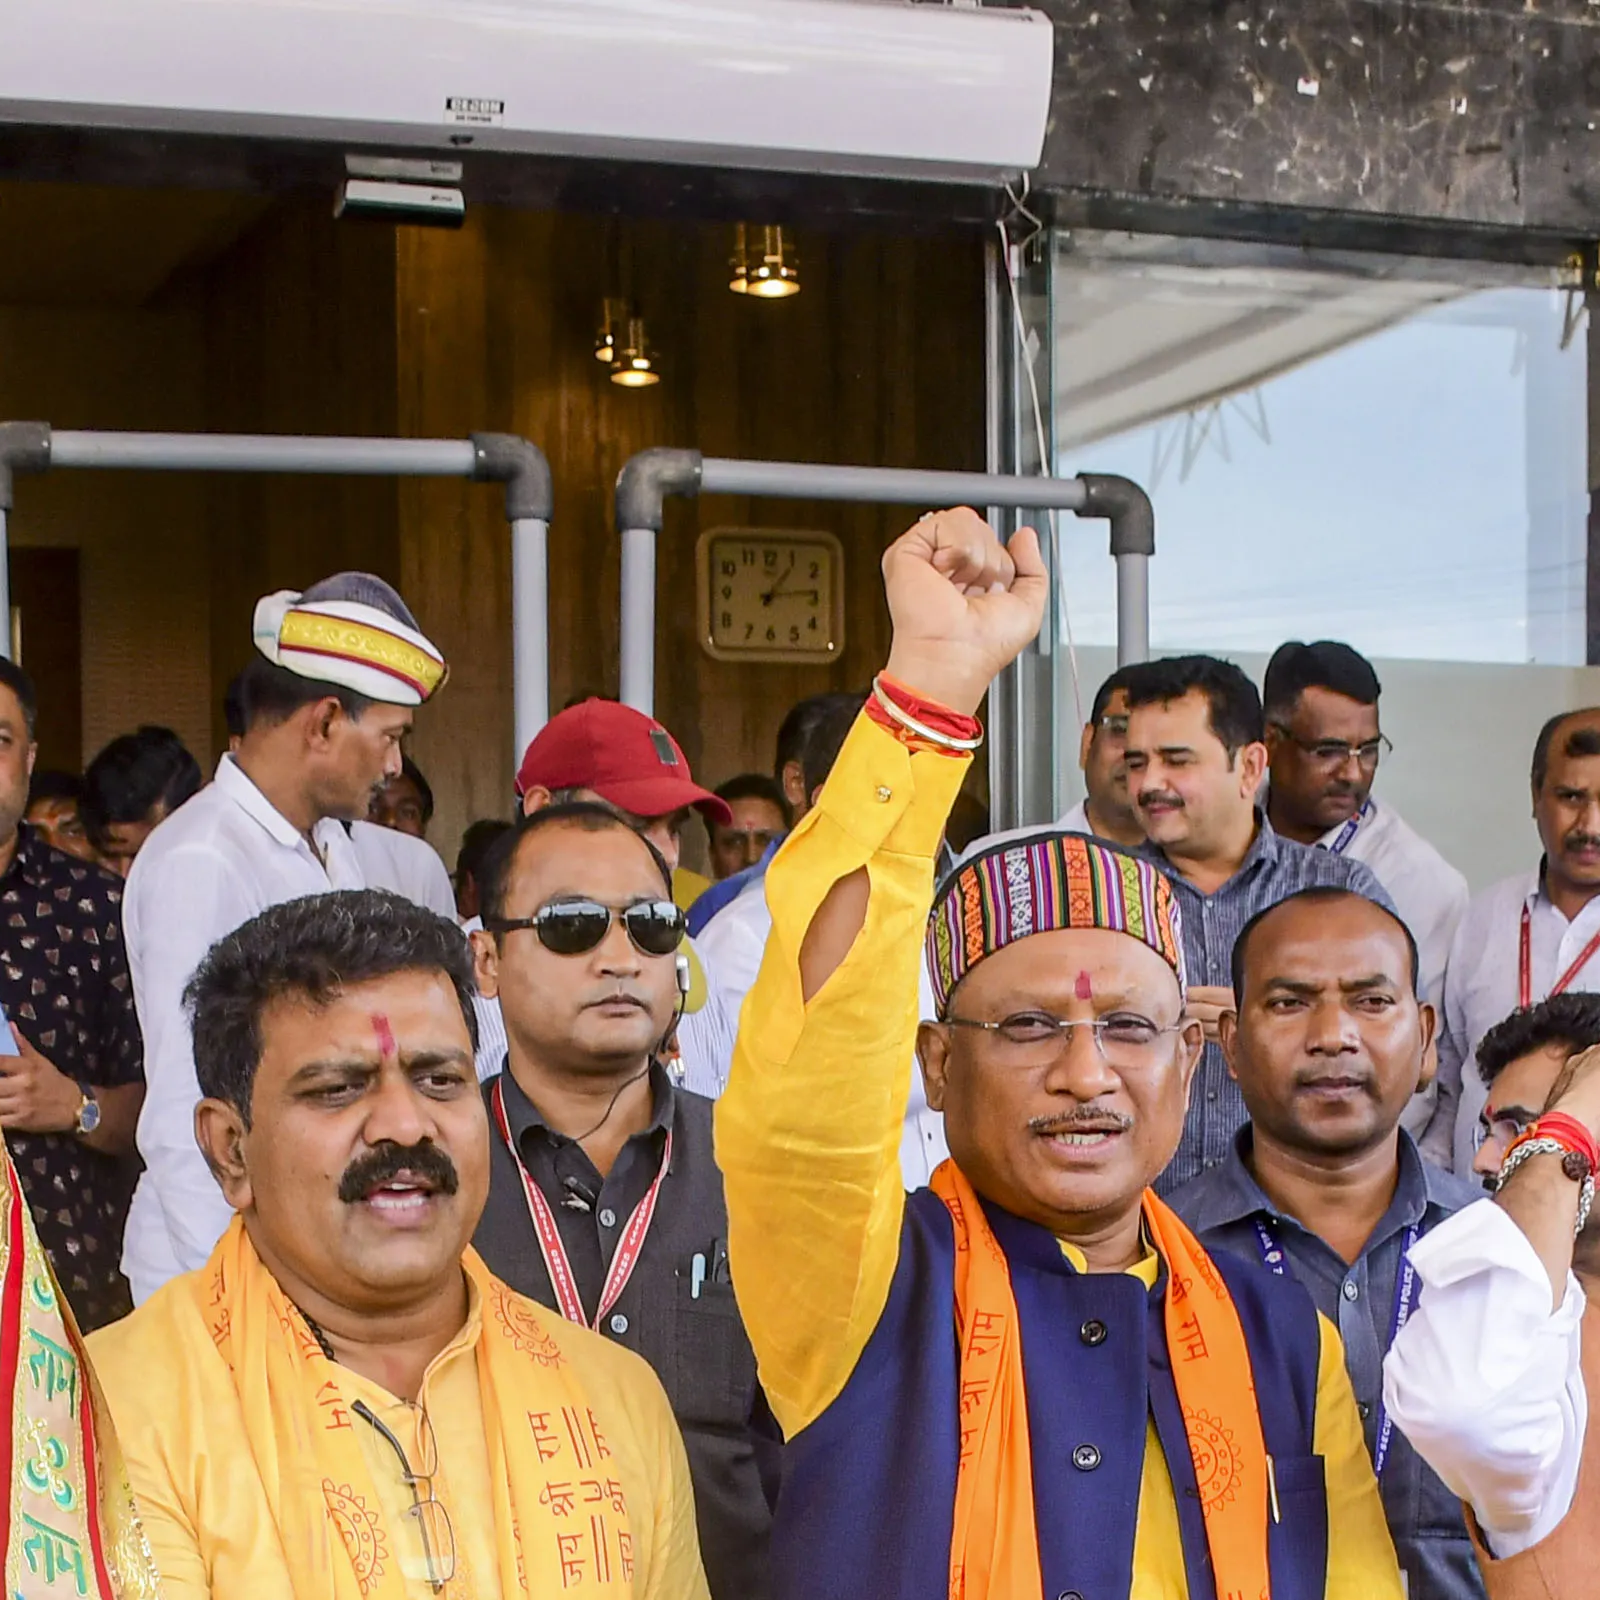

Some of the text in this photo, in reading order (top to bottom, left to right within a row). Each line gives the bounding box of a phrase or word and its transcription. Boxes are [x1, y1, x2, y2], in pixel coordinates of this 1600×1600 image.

[745, 623, 753, 639] 7
[766, 626, 775, 641] 6
[789, 626, 799, 642] 5
[966, 1308, 1004, 1361] राम
[1176, 1311, 1209, 1362] राम
[527, 1410, 586, 1589] जय श्री राम
[21, 1511, 87, 1597] राम
